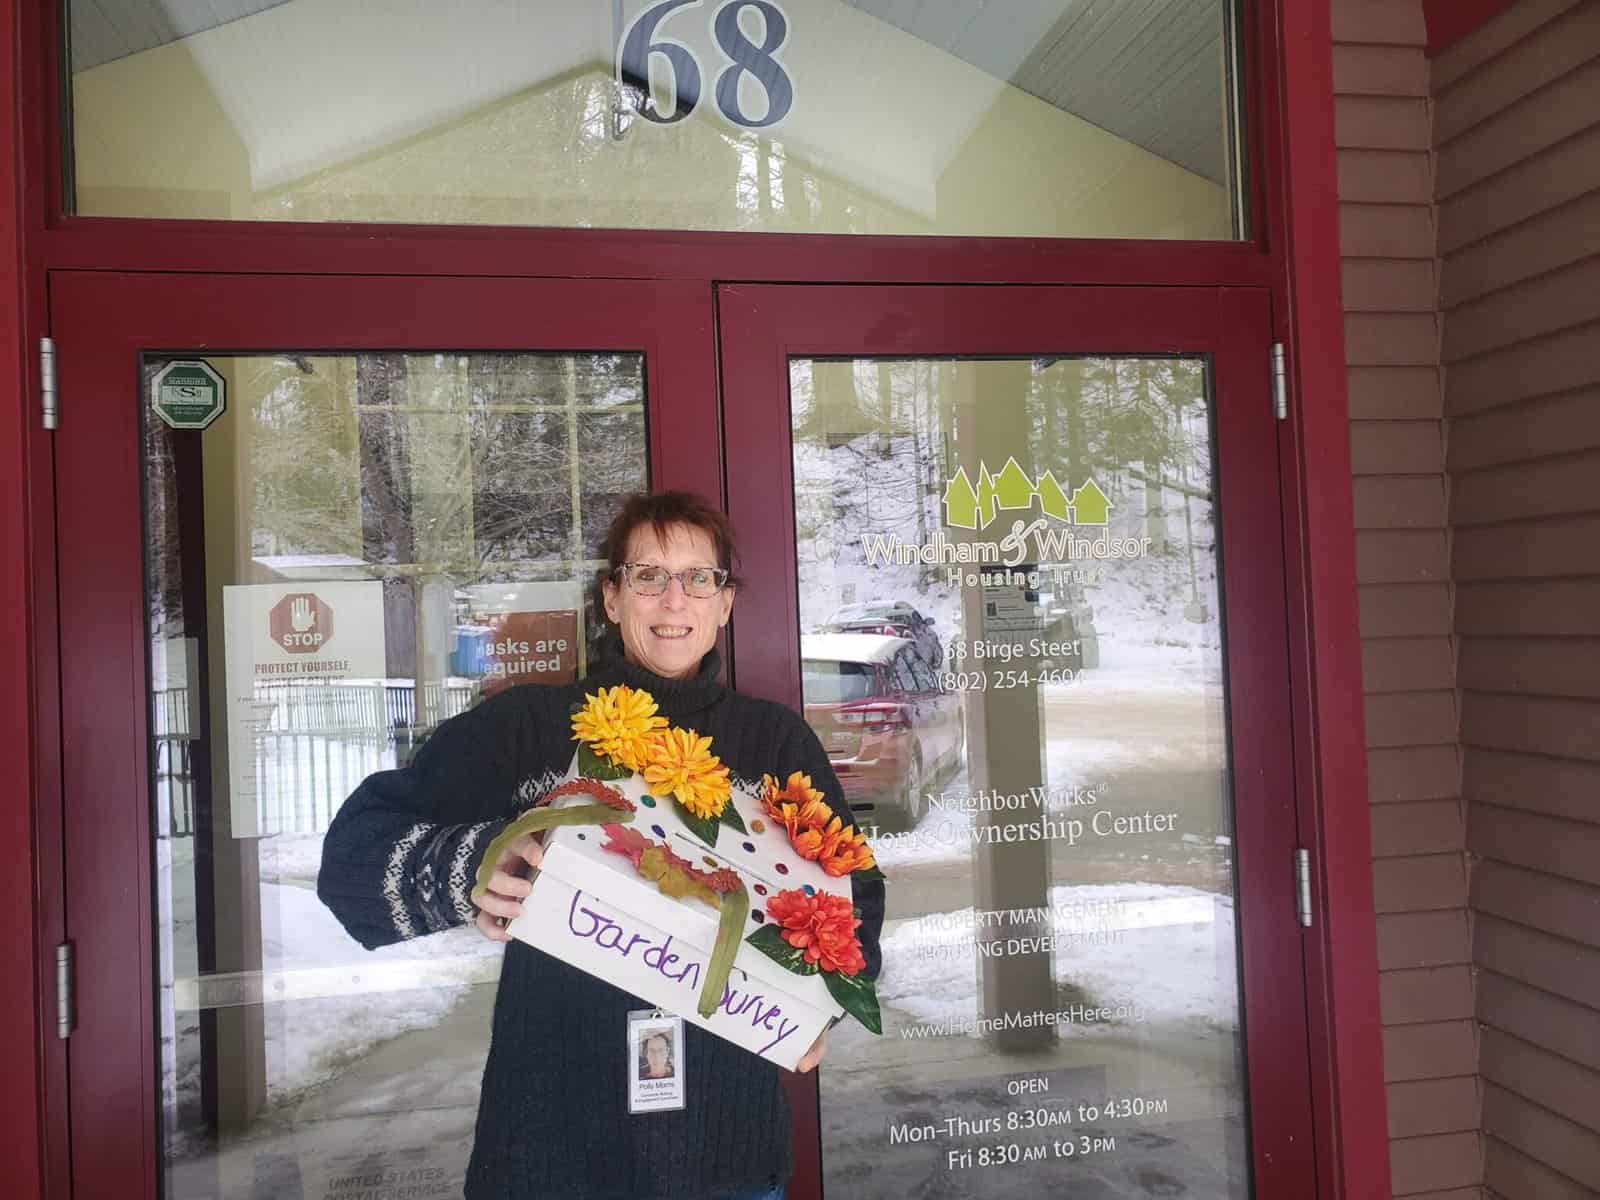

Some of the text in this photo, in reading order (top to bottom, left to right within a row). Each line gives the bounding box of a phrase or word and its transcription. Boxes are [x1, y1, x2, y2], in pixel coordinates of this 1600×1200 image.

[616, 0, 794, 127] 68
[862, 532, 999, 565] Windham
[1034, 527, 1152, 561] Windsor
[947, 567, 1106, 590] Housing Tru
[283, 632, 323, 647] STOP
[477, 637, 568, 656] asks are
[974, 640, 1024, 663] Birge
[1030, 638, 1081, 657] Steet
[254, 662, 299, 675] PROTECT
[480, 654, 561, 679] equired
[937, 671, 988, 694] (802)
[1091, 809, 1177, 837] Center
[568, 889, 799, 1056] Garden Survey
[1007, 1077, 1049, 1096] OPEN
[1078, 1104, 1099, 1123] to
[948, 1149, 972, 1170] Fri
[1054, 1138, 1075, 1158] to
